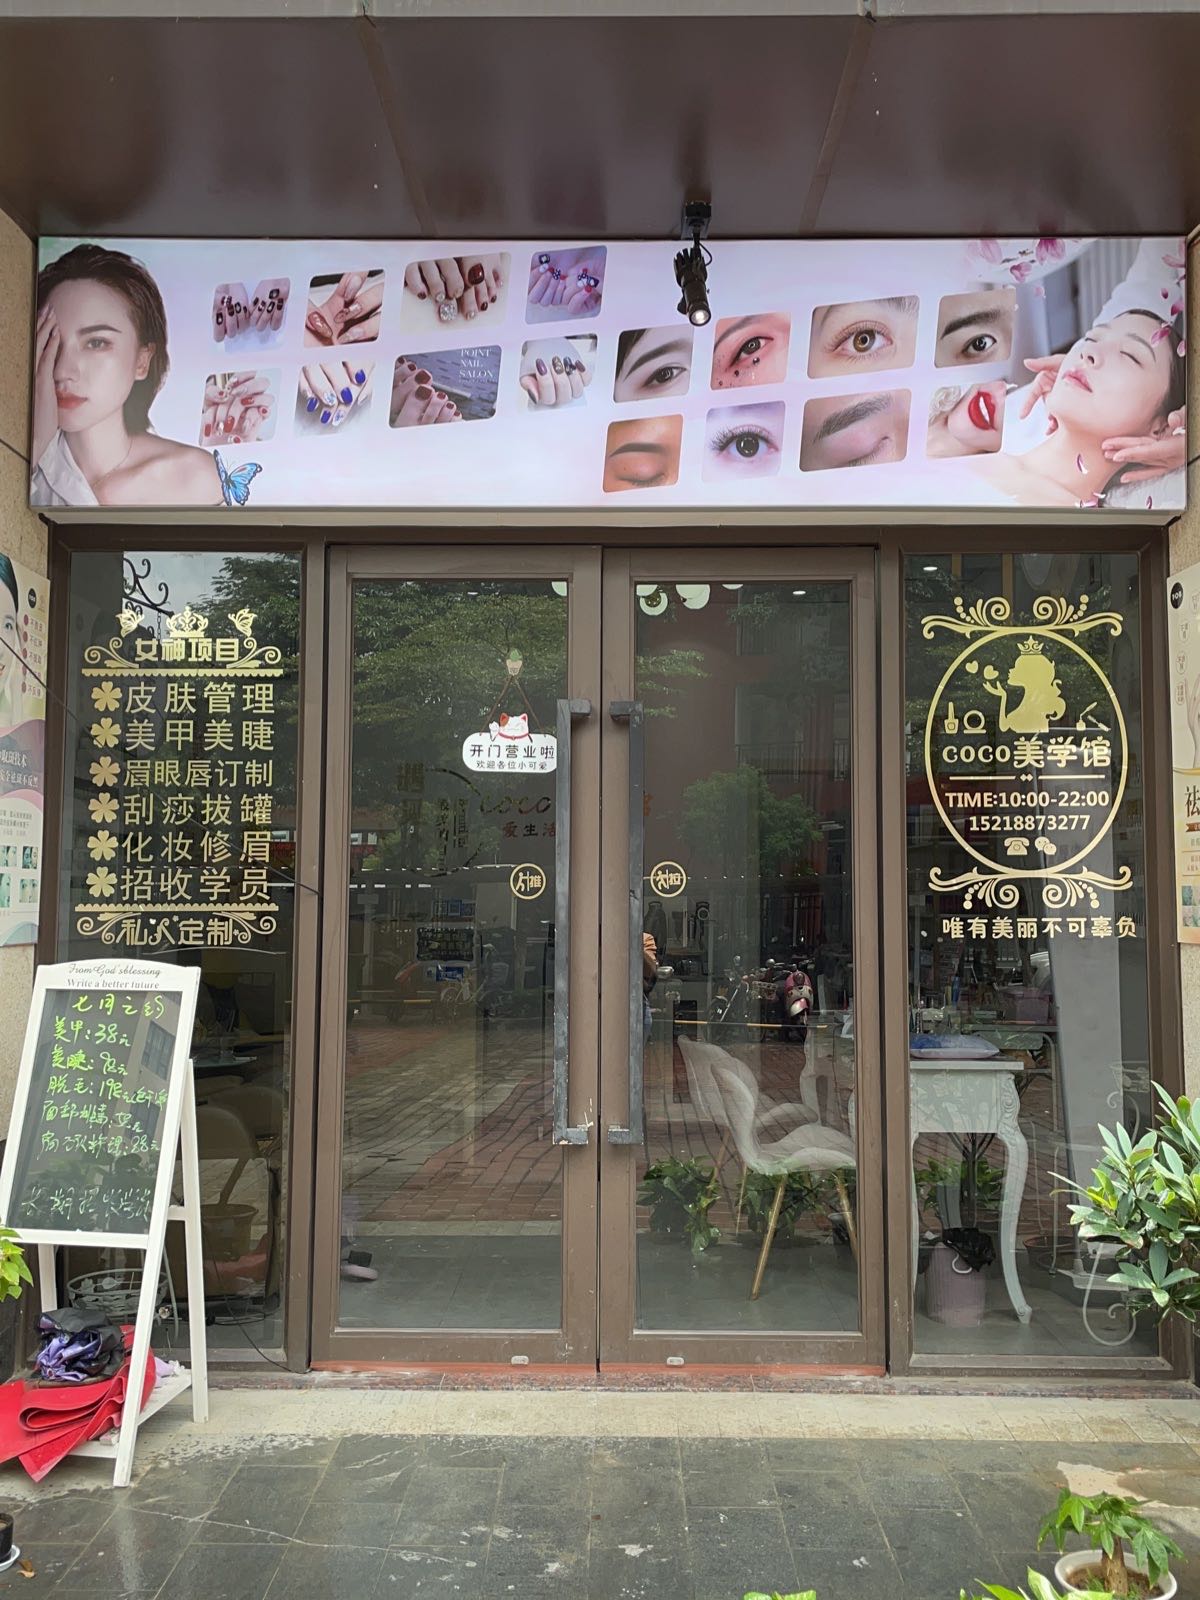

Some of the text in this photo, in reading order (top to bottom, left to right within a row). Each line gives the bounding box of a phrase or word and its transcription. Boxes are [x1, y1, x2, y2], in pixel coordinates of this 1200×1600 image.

[459, 369, 493, 378] SALON
[460, 359, 484, 368] NAIL
[134, 637, 239, 662] 女神项目
[124, 682, 275, 714] 皮肤管理
[125, 719, 275, 752] 美甲美睫
[469, 744, 555, 760] 开门营业啦
[123, 759, 273, 788] 眉眼唇订制
[476, 760, 548, 771] 欢迎各位小可爱
[122, 793, 272, 825] 刮痧拔罐
[945, 791, 1110, 809] TIME:10:00-22:00
[969, 815, 1091, 832] 15218873277
[121, 831, 271, 863] 化妆修眉
[120, 868, 271, 901] 招收学员
[529, 875, 542, 888] 推
[668, 872, 681, 886] 拉
[115, 916, 234, 946] 私人定制
[942, 915, 1137, 939] 唯有美丽不可辜负
[66, 979, 93, 987] Write
[102, 979, 129, 988] better
